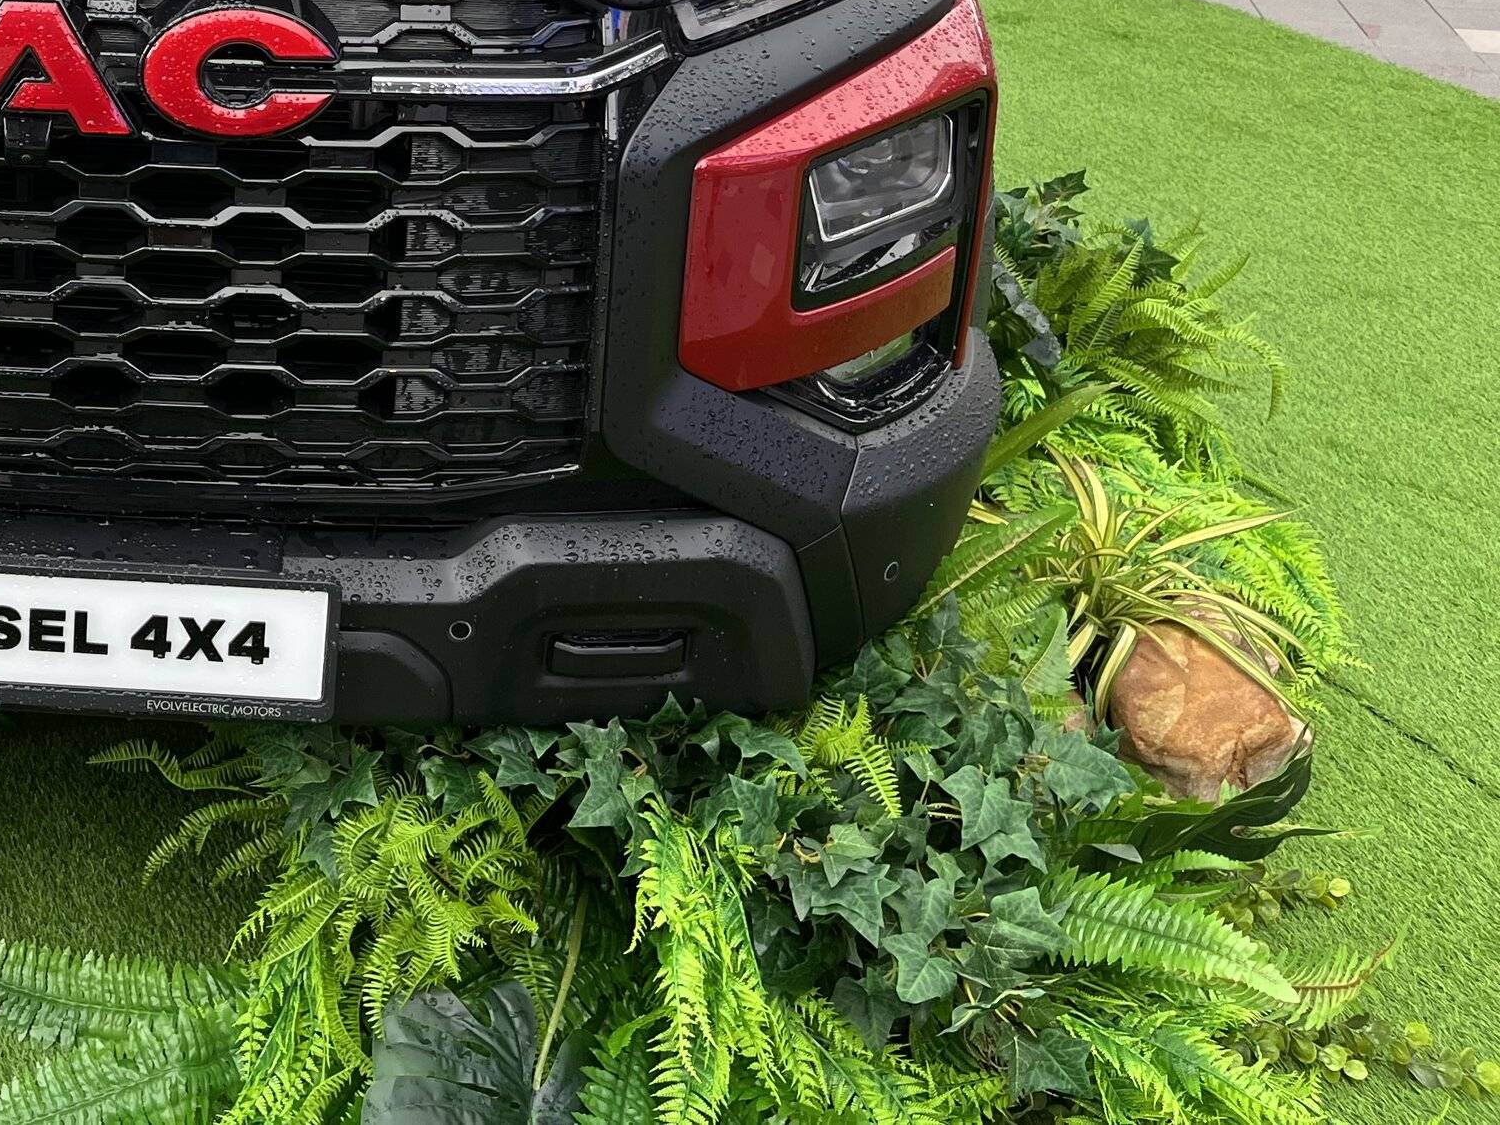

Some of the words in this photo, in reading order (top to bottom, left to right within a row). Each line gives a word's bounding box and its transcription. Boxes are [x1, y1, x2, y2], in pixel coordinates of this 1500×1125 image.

[130, 614, 271, 665] 4X4
[146, 699, 231, 714] EVOLVELECTRIC
[232, 706, 282, 718] MOTORS
